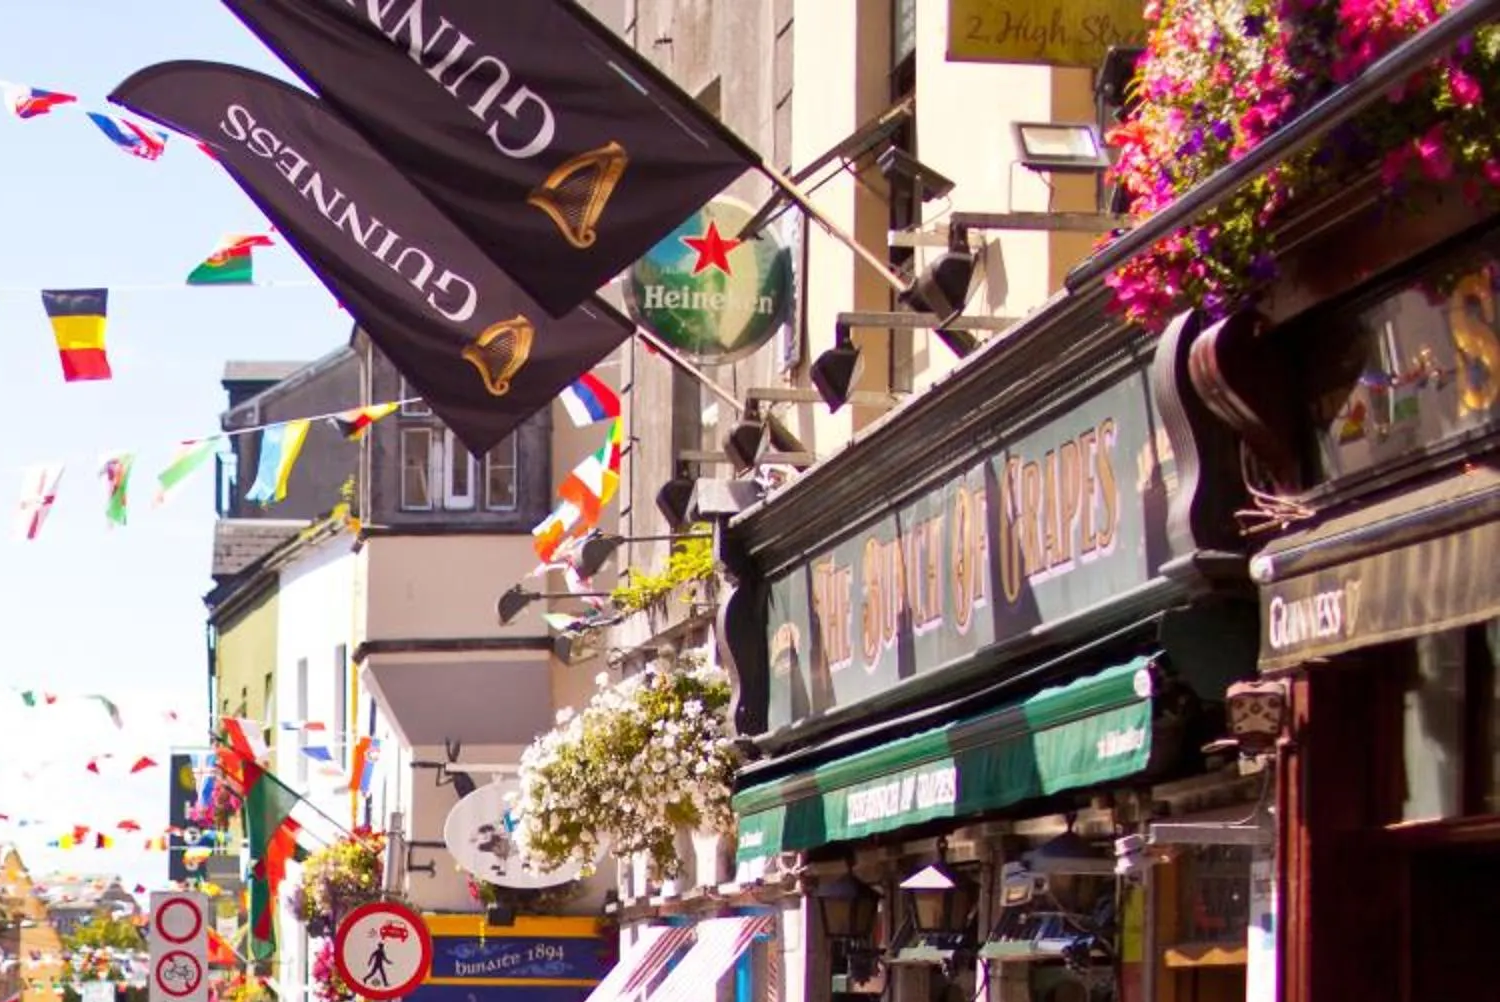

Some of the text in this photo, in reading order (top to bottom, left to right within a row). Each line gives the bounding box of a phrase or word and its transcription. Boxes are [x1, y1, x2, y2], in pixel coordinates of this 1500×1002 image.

[352, 0, 556, 159] GUIN
[996, 10, 1067, 55] High
[219, 104, 478, 322] GUINNESS
[643, 284, 773, 314] Heineen
[814, 416, 1119, 673] THE BUNCH OF GRAPES
[528, 943, 564, 962] 1894
